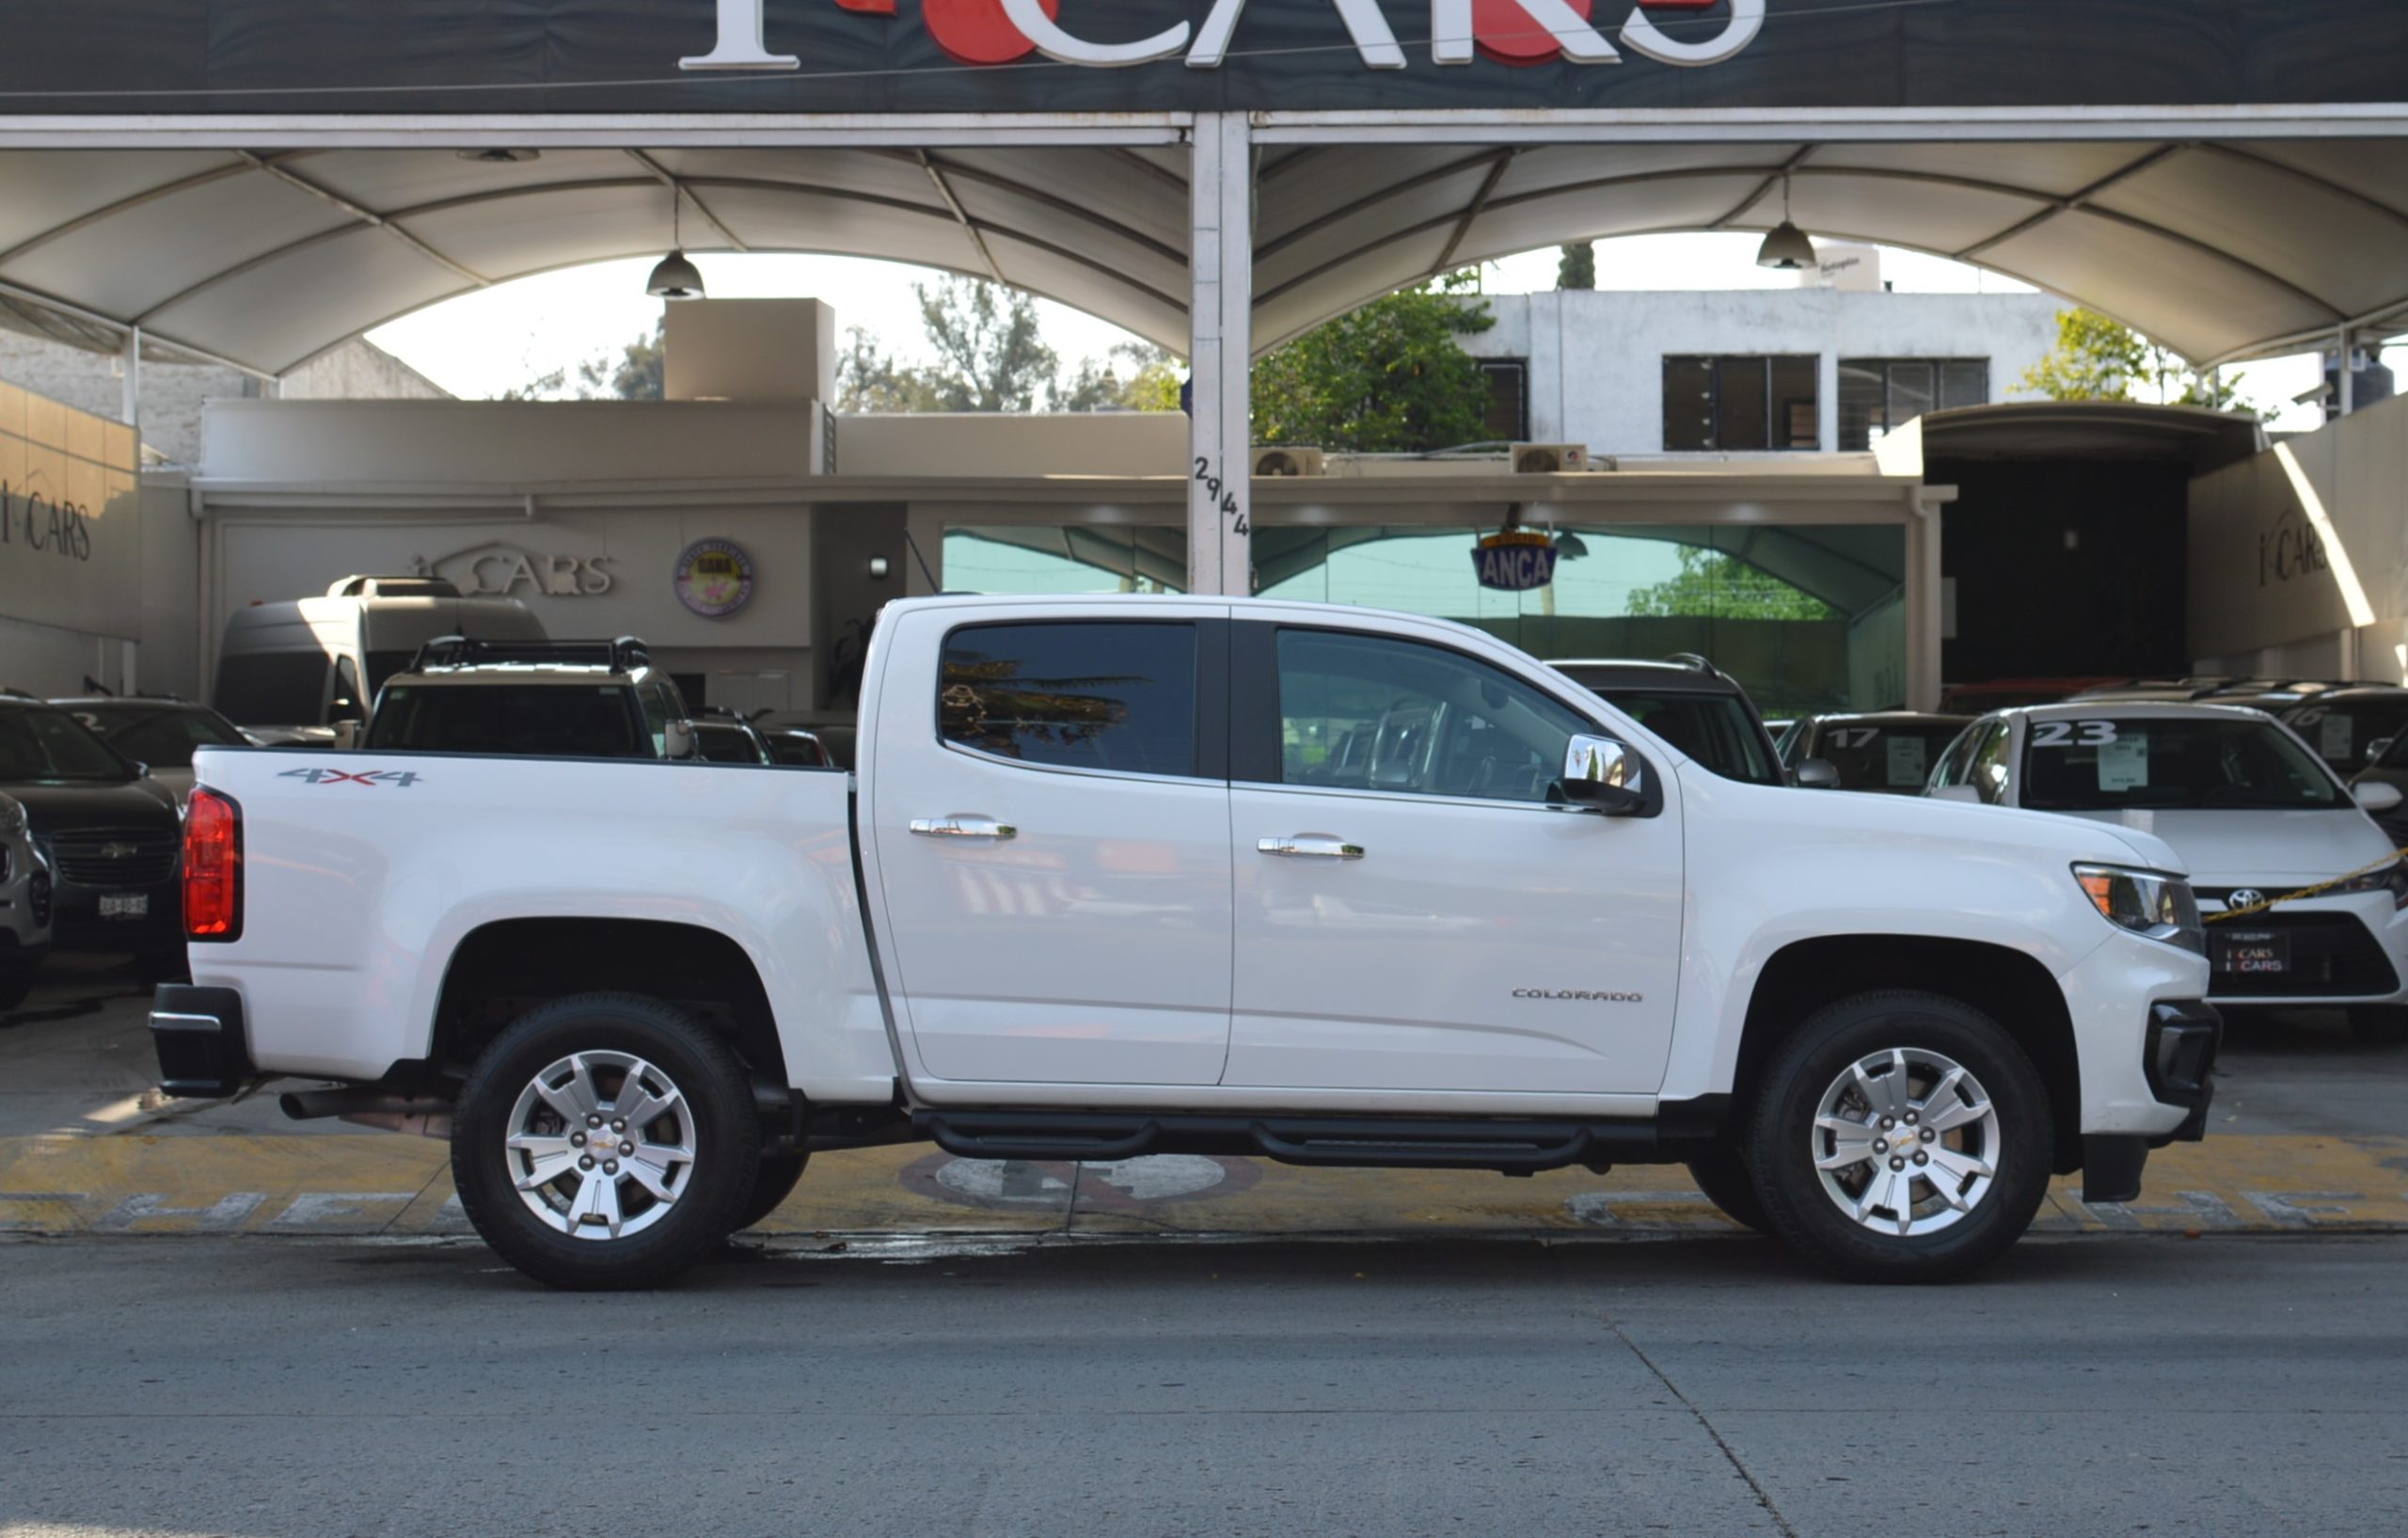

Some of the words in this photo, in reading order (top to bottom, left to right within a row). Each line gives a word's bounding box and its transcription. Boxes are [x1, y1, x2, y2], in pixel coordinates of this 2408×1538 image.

[1195, 456, 1249, 536] 2944
[25, 491, 90, 562] CARS
[1482, 548, 1550, 587] ANCA
[1828, 727, 1879, 748] 17
[2031, 721, 2118, 747] 23
[1512, 988, 1643, 1003] COLORADO
